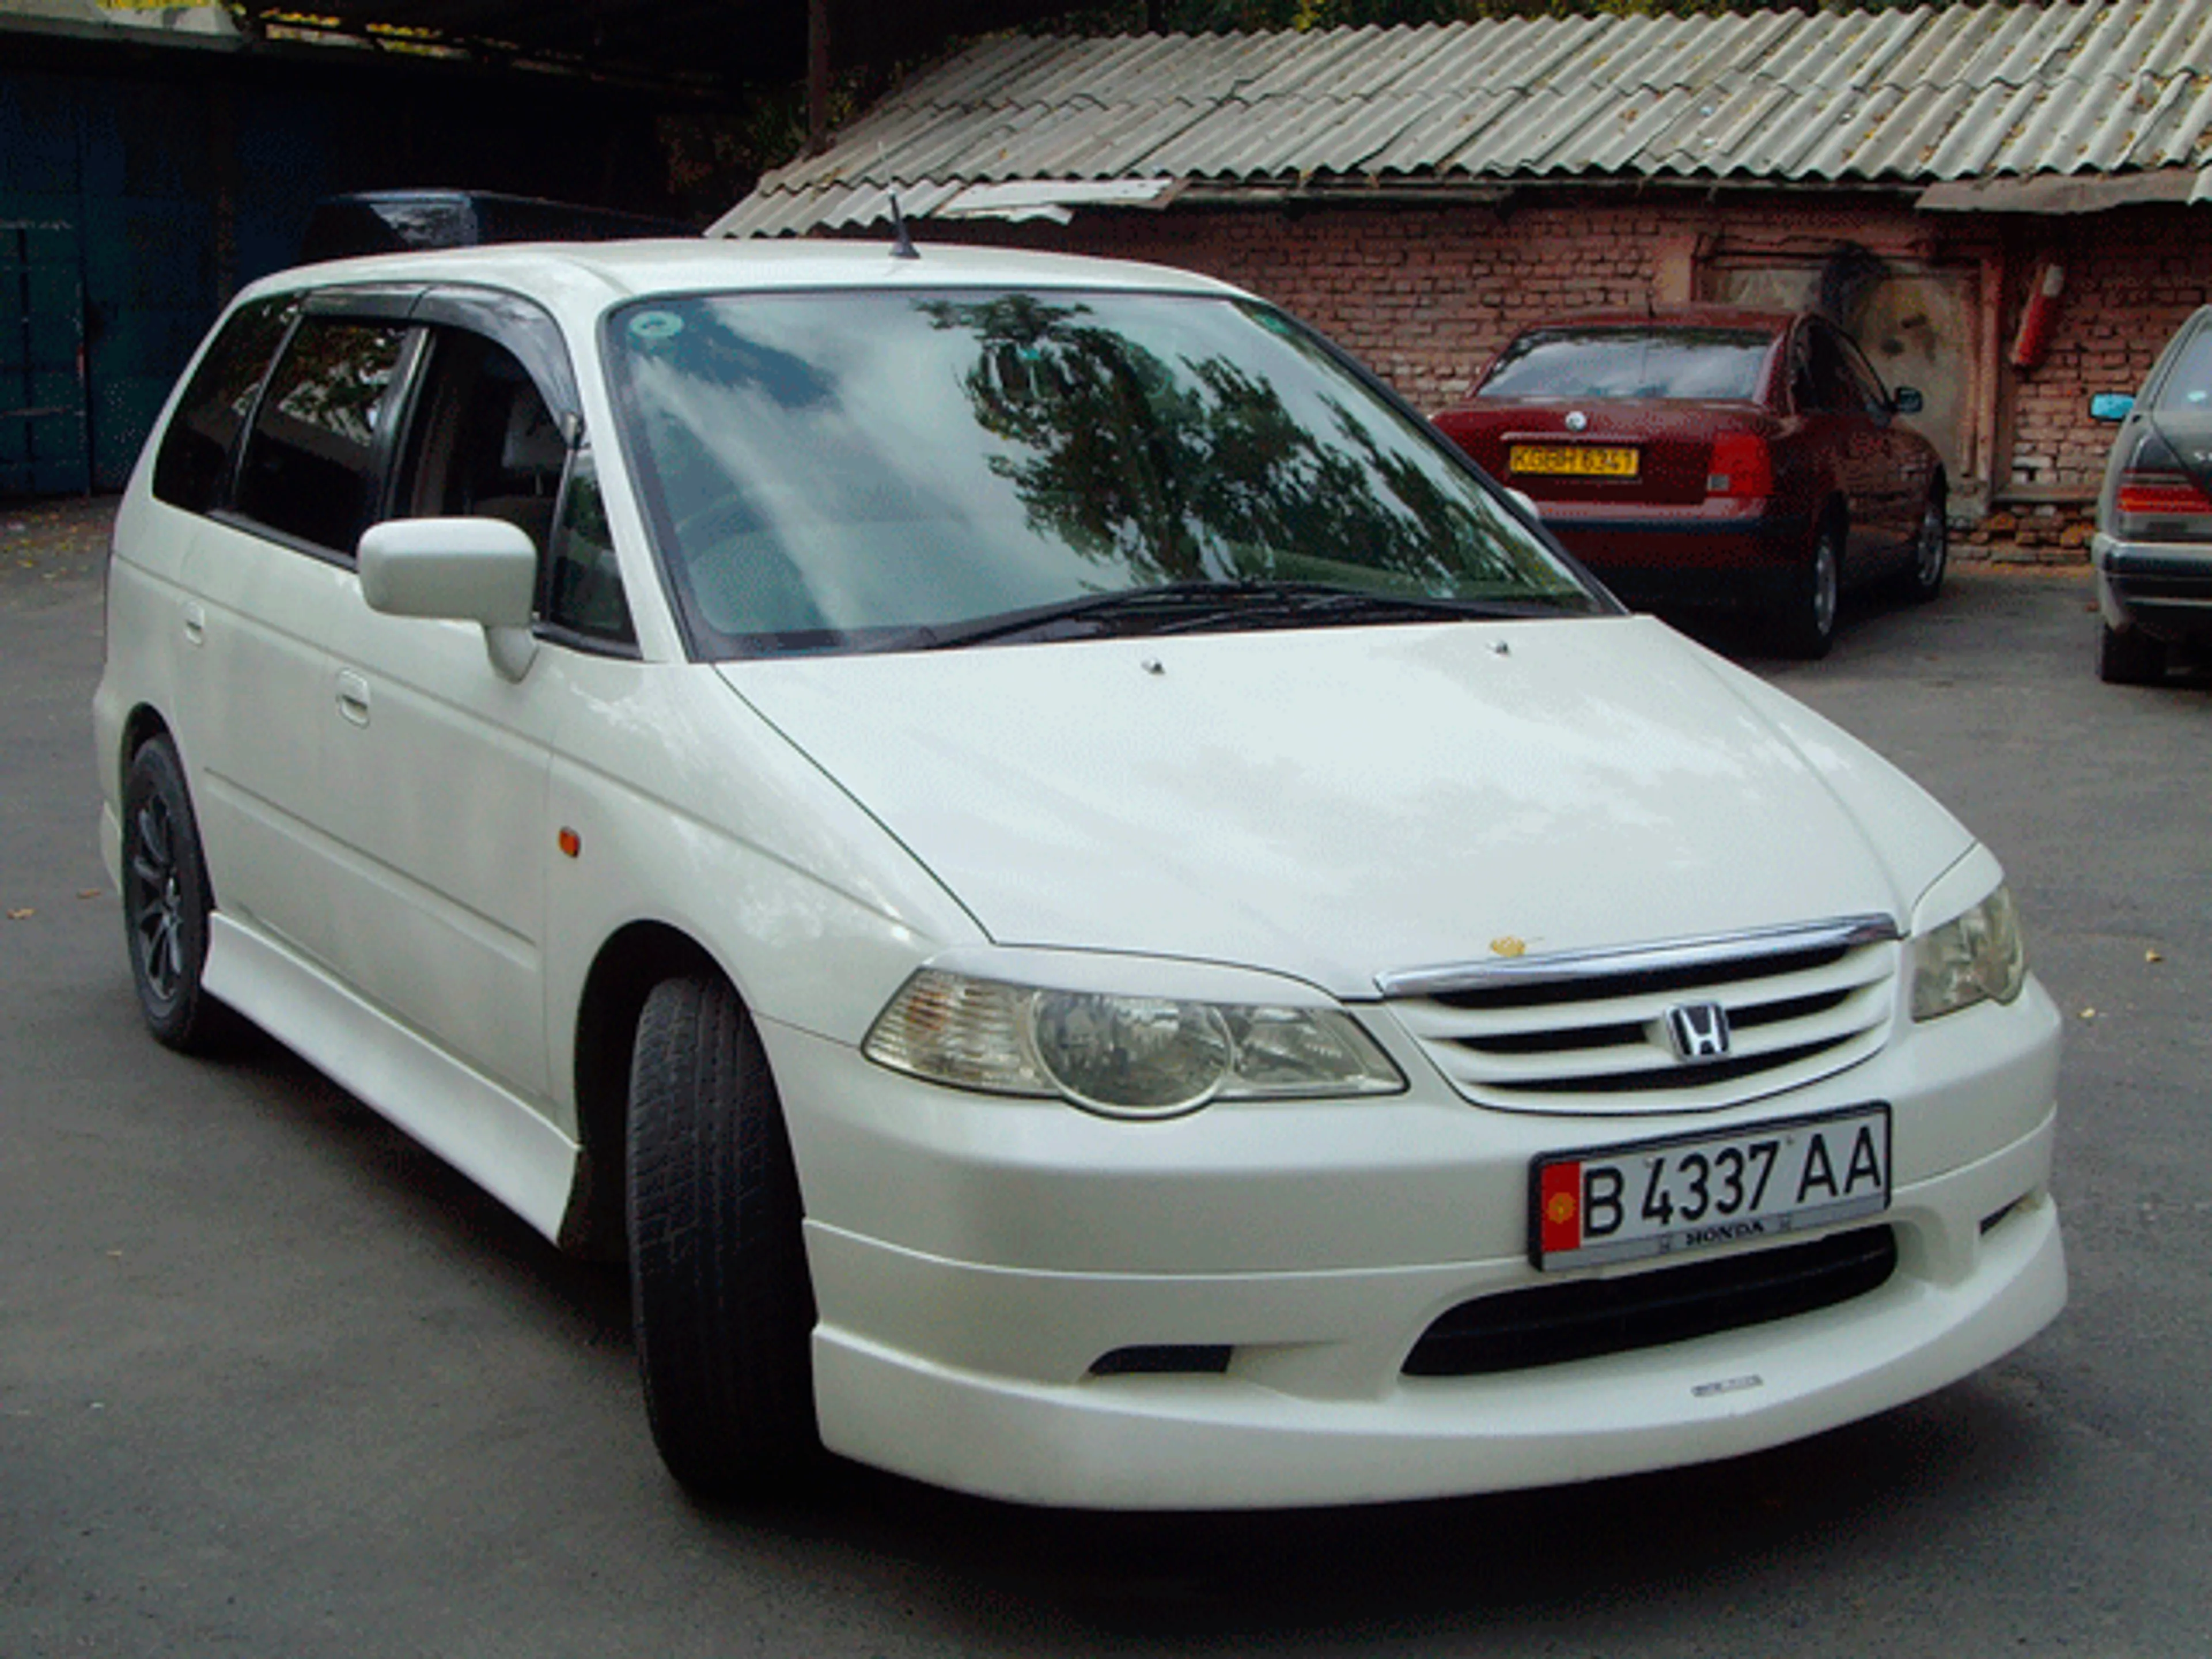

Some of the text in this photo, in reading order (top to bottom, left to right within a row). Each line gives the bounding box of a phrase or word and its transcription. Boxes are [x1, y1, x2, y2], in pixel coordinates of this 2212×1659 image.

[1584, 1126, 1881, 1238] B 4337 AA
[1685, 1220, 1764, 1246] HONDA
